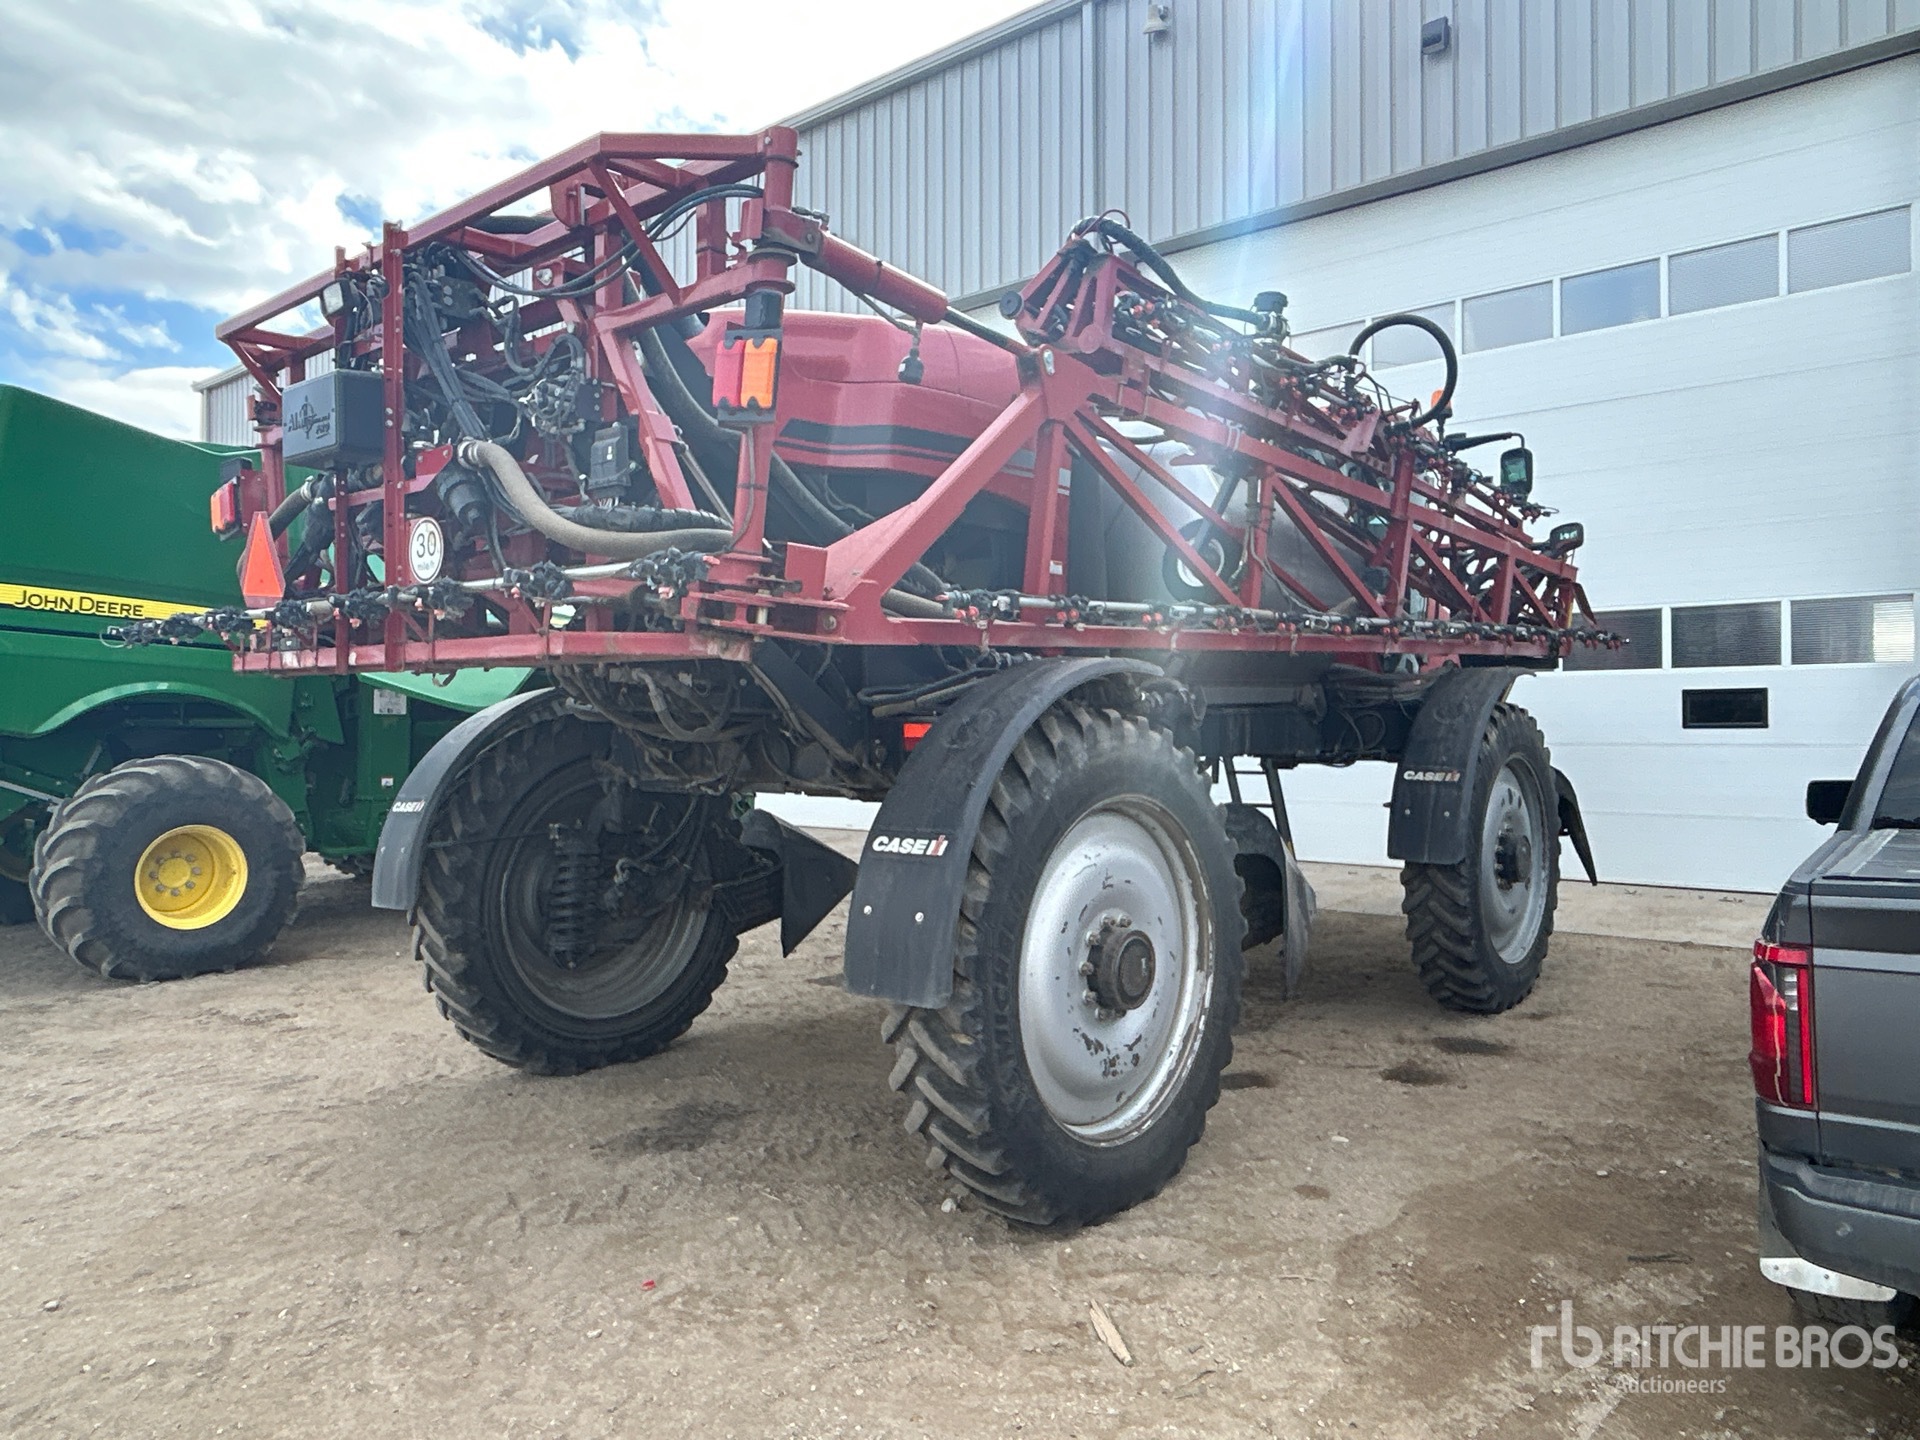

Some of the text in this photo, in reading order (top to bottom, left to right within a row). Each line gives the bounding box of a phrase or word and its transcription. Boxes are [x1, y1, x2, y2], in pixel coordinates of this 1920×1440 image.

[416, 531, 437, 558] 30
[14, 589, 145, 617] JOHN DEERE
